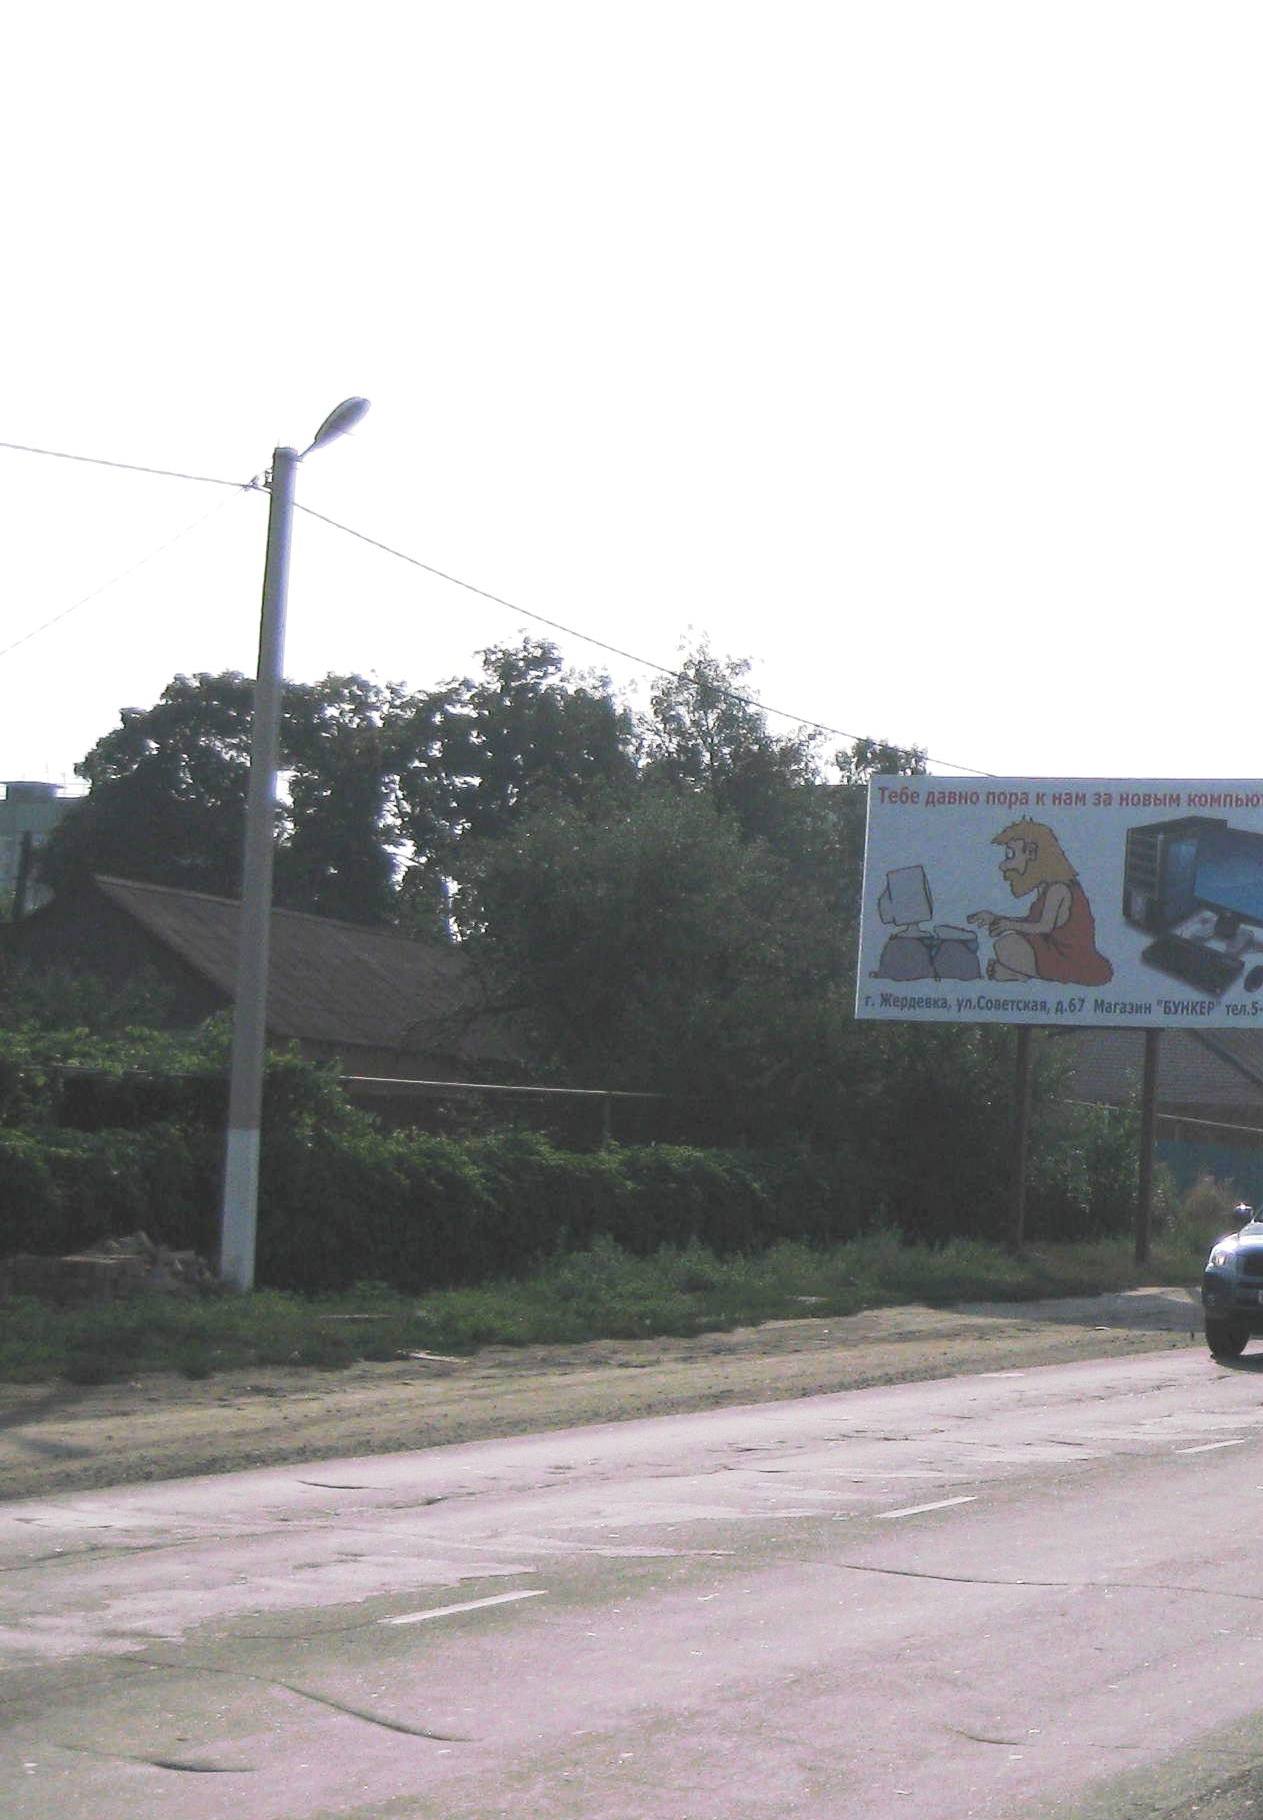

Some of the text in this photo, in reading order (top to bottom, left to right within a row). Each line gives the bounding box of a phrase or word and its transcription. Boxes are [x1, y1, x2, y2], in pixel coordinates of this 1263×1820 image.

[878, 787, 920, 805] Тебе
[925, 788, 980, 808] давно
[986, 789, 1029, 810] пора
[1036, 790, 1046, 806] к
[1052, 790, 1087, 808] нам
[1093, 791, 1113, 807] за
[1119, 791, 1180, 808] новым
[864, 996, 876, 1008] г.
[879, 993, 952, 1012] Жердевка,
[1055, 998, 1085, 1016] д.67
[1093, 999, 1152, 1015] Магазин
[1157, 999, 1222, 1017] "БУНКЕР"
